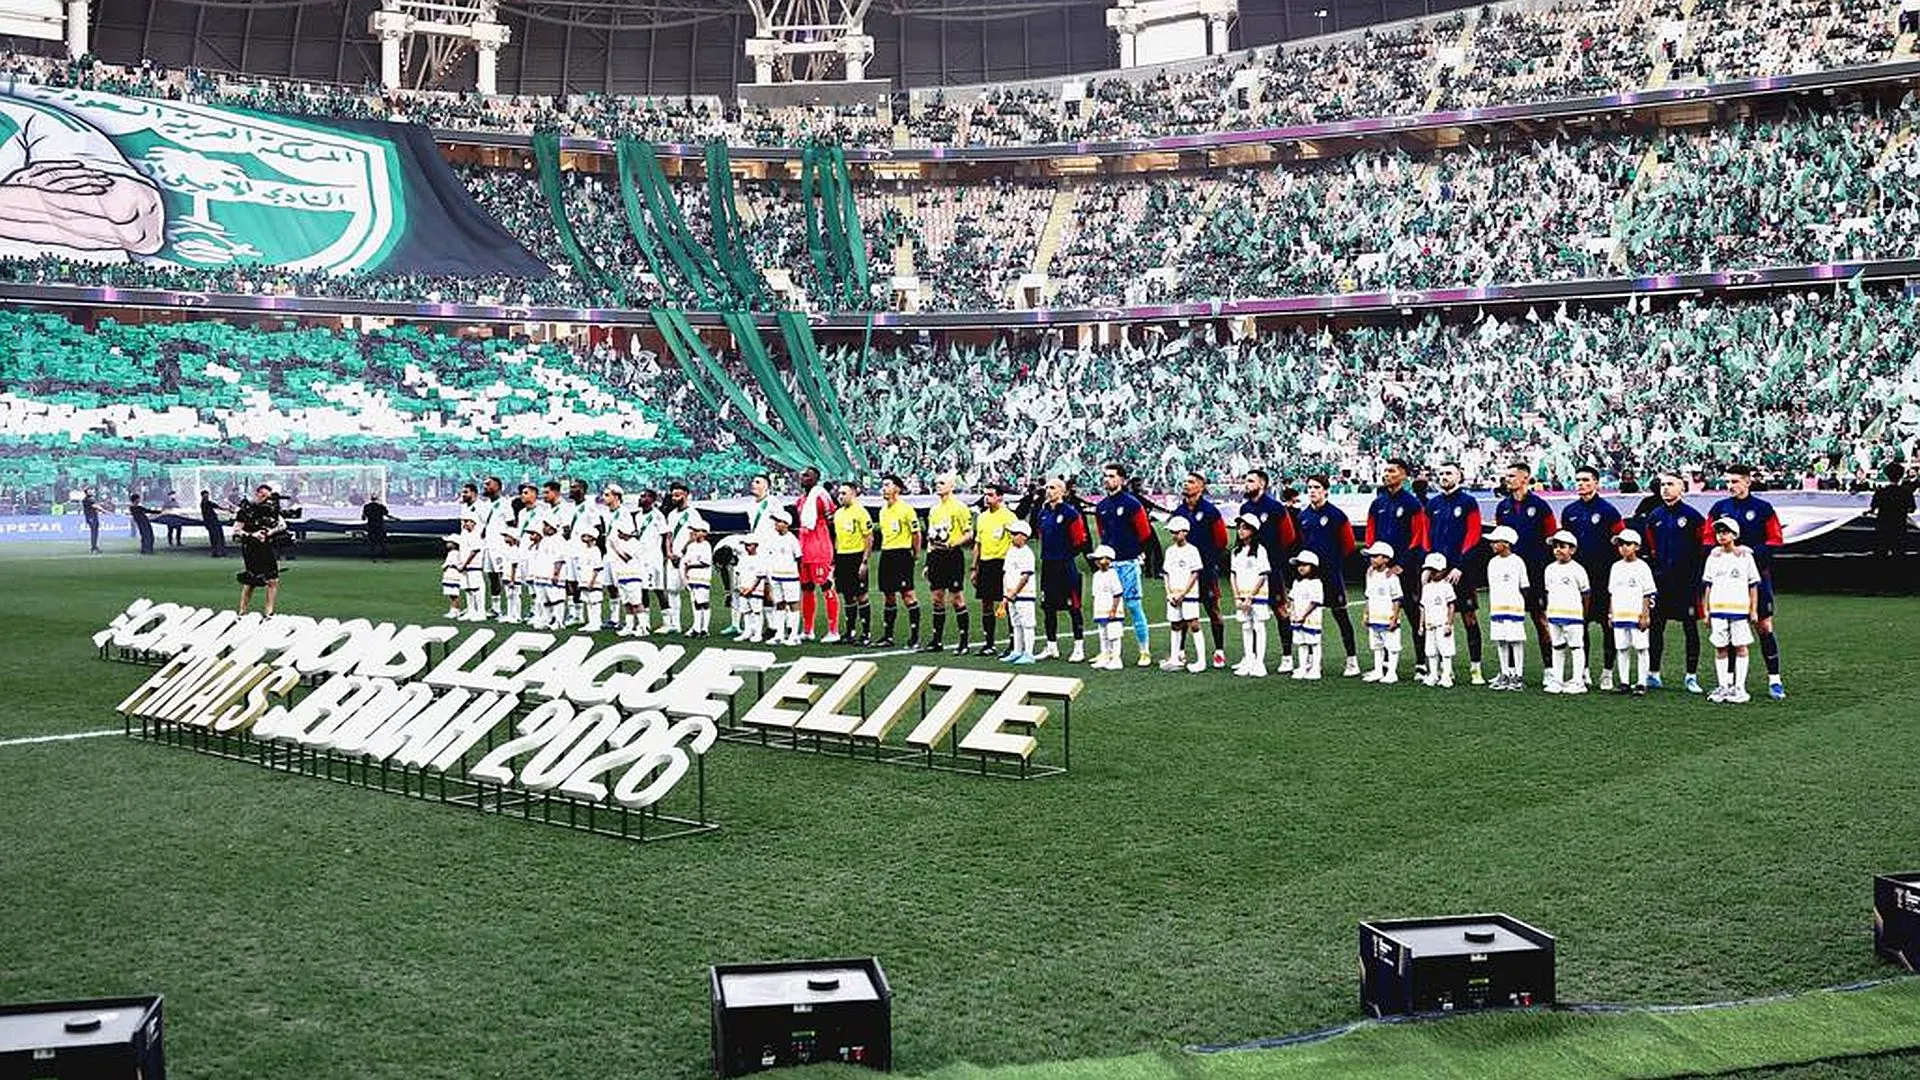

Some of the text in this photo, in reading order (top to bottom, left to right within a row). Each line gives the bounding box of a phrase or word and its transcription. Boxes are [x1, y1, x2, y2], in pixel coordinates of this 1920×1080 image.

[113, 602, 459, 682] CHAMPIONS
[422, 627, 777, 721] LEAGUE
[742, 656, 1085, 761] ELITE
[115, 652, 718, 808] FINALS JEDDAH 2026
